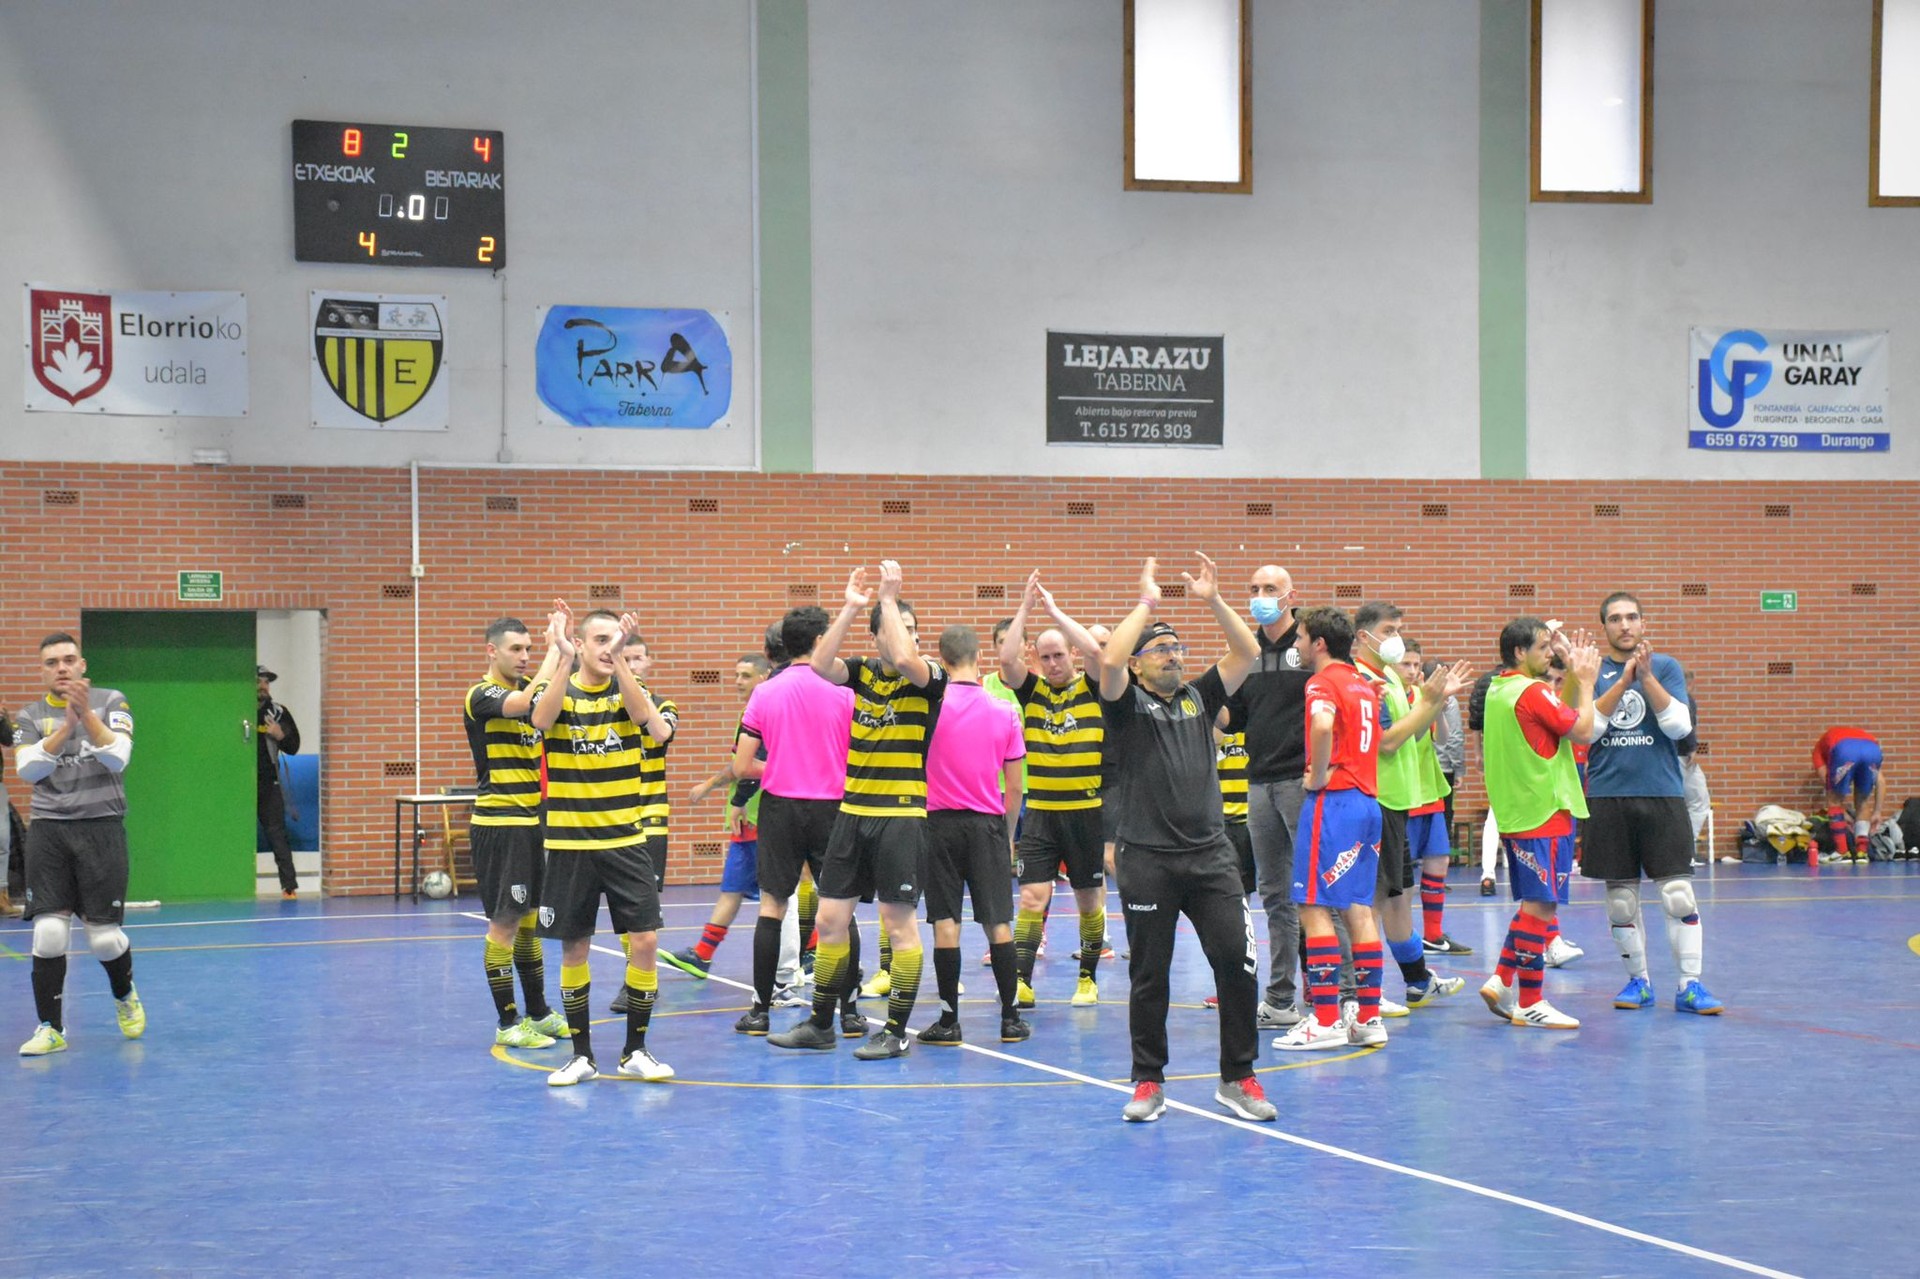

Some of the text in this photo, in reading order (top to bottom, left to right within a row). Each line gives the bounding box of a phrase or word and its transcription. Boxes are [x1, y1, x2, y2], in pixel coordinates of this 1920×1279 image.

[343, 128, 361, 156] 8
[392, 132, 408, 158] 2
[474, 136, 490, 162] 4
[295, 163, 375, 184] ETXEKOAK
[425, 169, 501, 190] BISITARIAK
[359, 231, 375, 256] 4
[478, 236, 494, 262] 2
[120, 312, 242, 341] Elorrioko
[1063, 344, 1211, 371] LEJARAZU
[144, 359, 207, 385] udala
[395, 358, 416, 385] E
[1094, 372, 1187, 392] TABERNA
[1785, 366, 1862, 386] GARAY
[618, 401, 673, 417] Taberna
[1075, 406, 1110, 417] Abierto
[1111, 407, 1132, 418] bajo
[1168, 409, 1197, 419] previa
[1866, 405, 1882, 413] GAS
[1080, 421, 1192, 439] T. 615 726 303
[1804, 416, 1855, 424] BEROGINTZA
[1861, 416, 1884, 424] GASA
[1705, 433, 1875, 449] 659 673 790 Durango
[1359, 698, 1373, 753] 5
[1610, 736, 1654, 747] MOINHO
